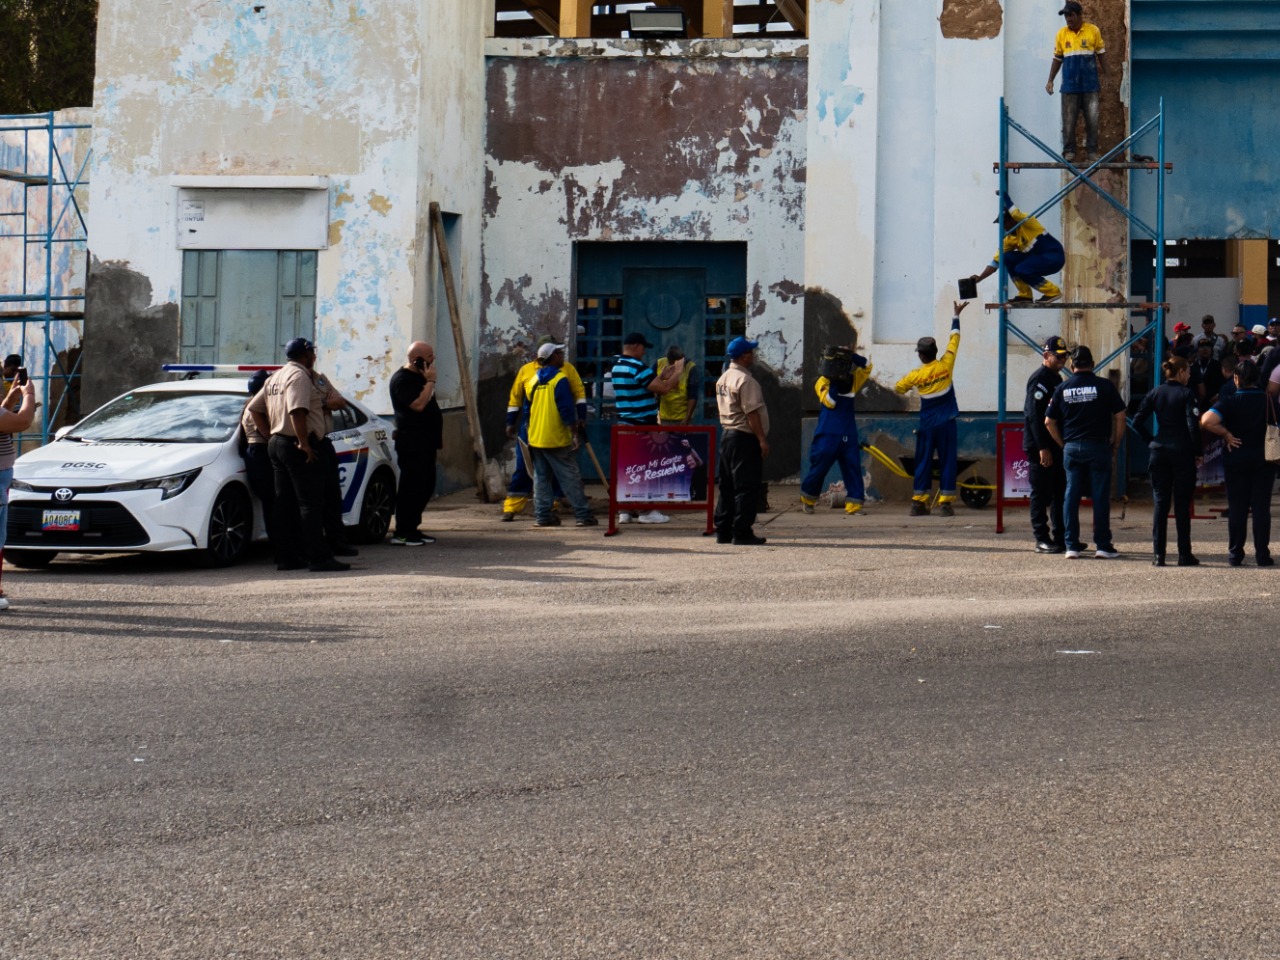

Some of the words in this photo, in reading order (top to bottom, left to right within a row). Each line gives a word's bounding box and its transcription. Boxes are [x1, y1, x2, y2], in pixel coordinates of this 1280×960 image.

[648, 459, 659, 469] Mi
[660, 454, 683, 467] Gente
[628, 473, 641, 485] Se
[644, 462, 686, 481] Resuelve
[1014, 468, 1028, 480] Se
